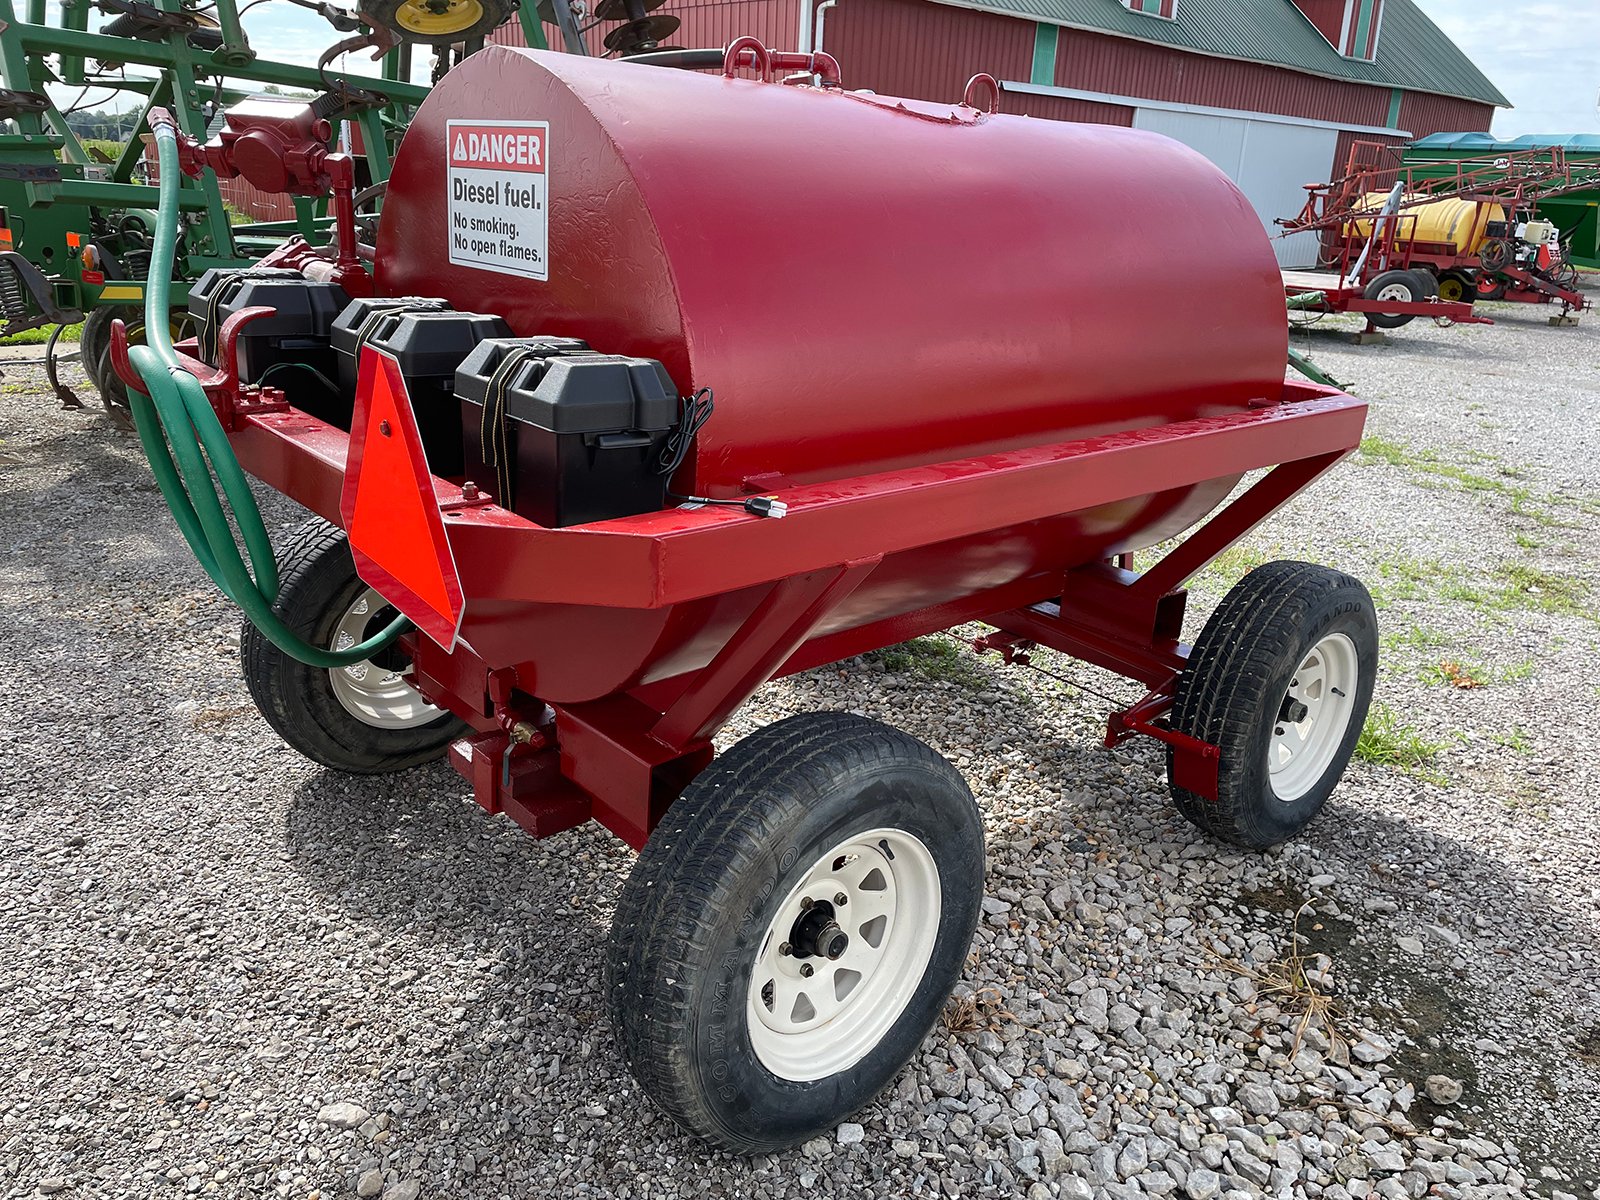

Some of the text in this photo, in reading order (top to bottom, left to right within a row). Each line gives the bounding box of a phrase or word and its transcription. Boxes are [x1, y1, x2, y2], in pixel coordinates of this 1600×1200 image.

[468, 133, 541, 166] DANGER
[453, 177, 541, 210] Diesel fuel.
[454, 211, 520, 241] No smoking.
[454, 232, 542, 263] No open flames.
[708, 846, 800, 1102] COMMANDO
